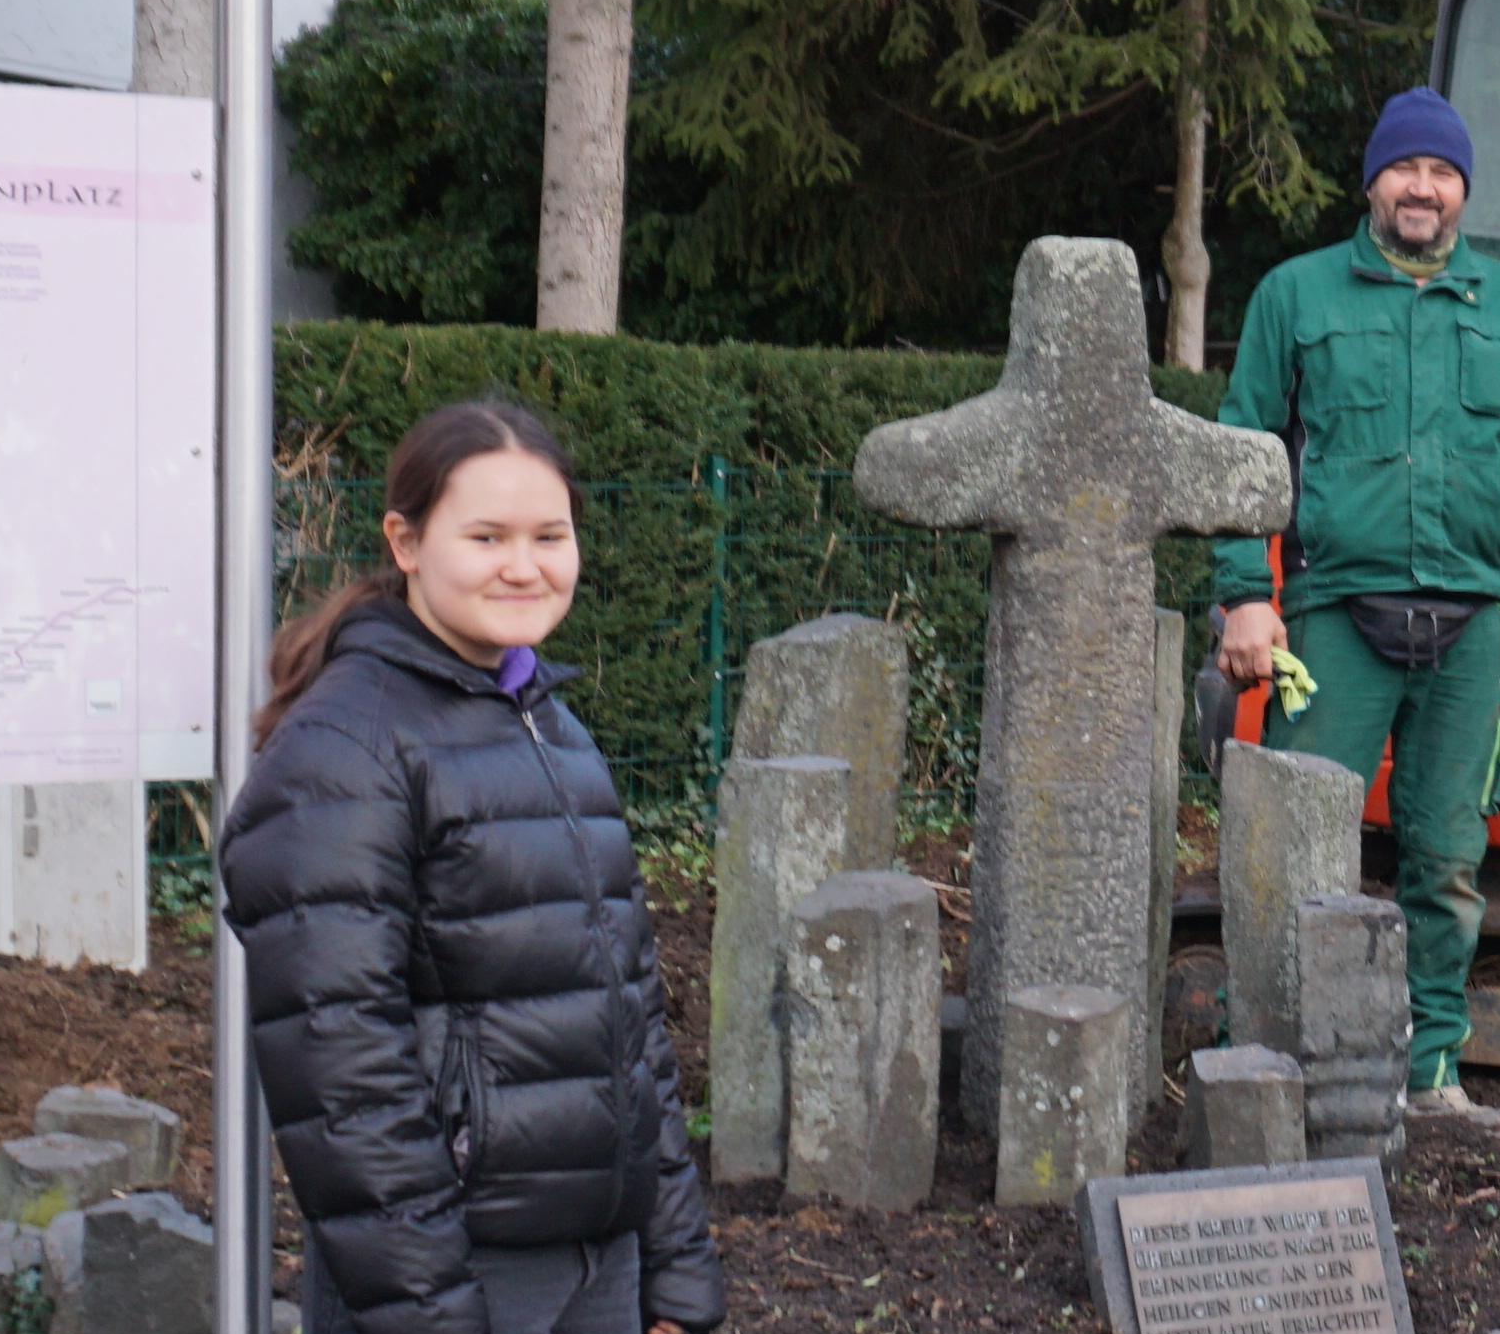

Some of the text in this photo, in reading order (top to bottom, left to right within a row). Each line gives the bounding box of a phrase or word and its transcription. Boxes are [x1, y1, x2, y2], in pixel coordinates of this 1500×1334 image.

[1129, 1205, 1370, 1244] DIESES KREUZ WURDE DER
[1284, 1235, 1335, 1257] NACH
[1340, 1231, 1375, 1252] ZUR
[1138, 1259, 1354, 1298] ERINNERUNG AN DEN
[1143, 1281, 1385, 1324] HEILIGEN BONIFATIUS IM
